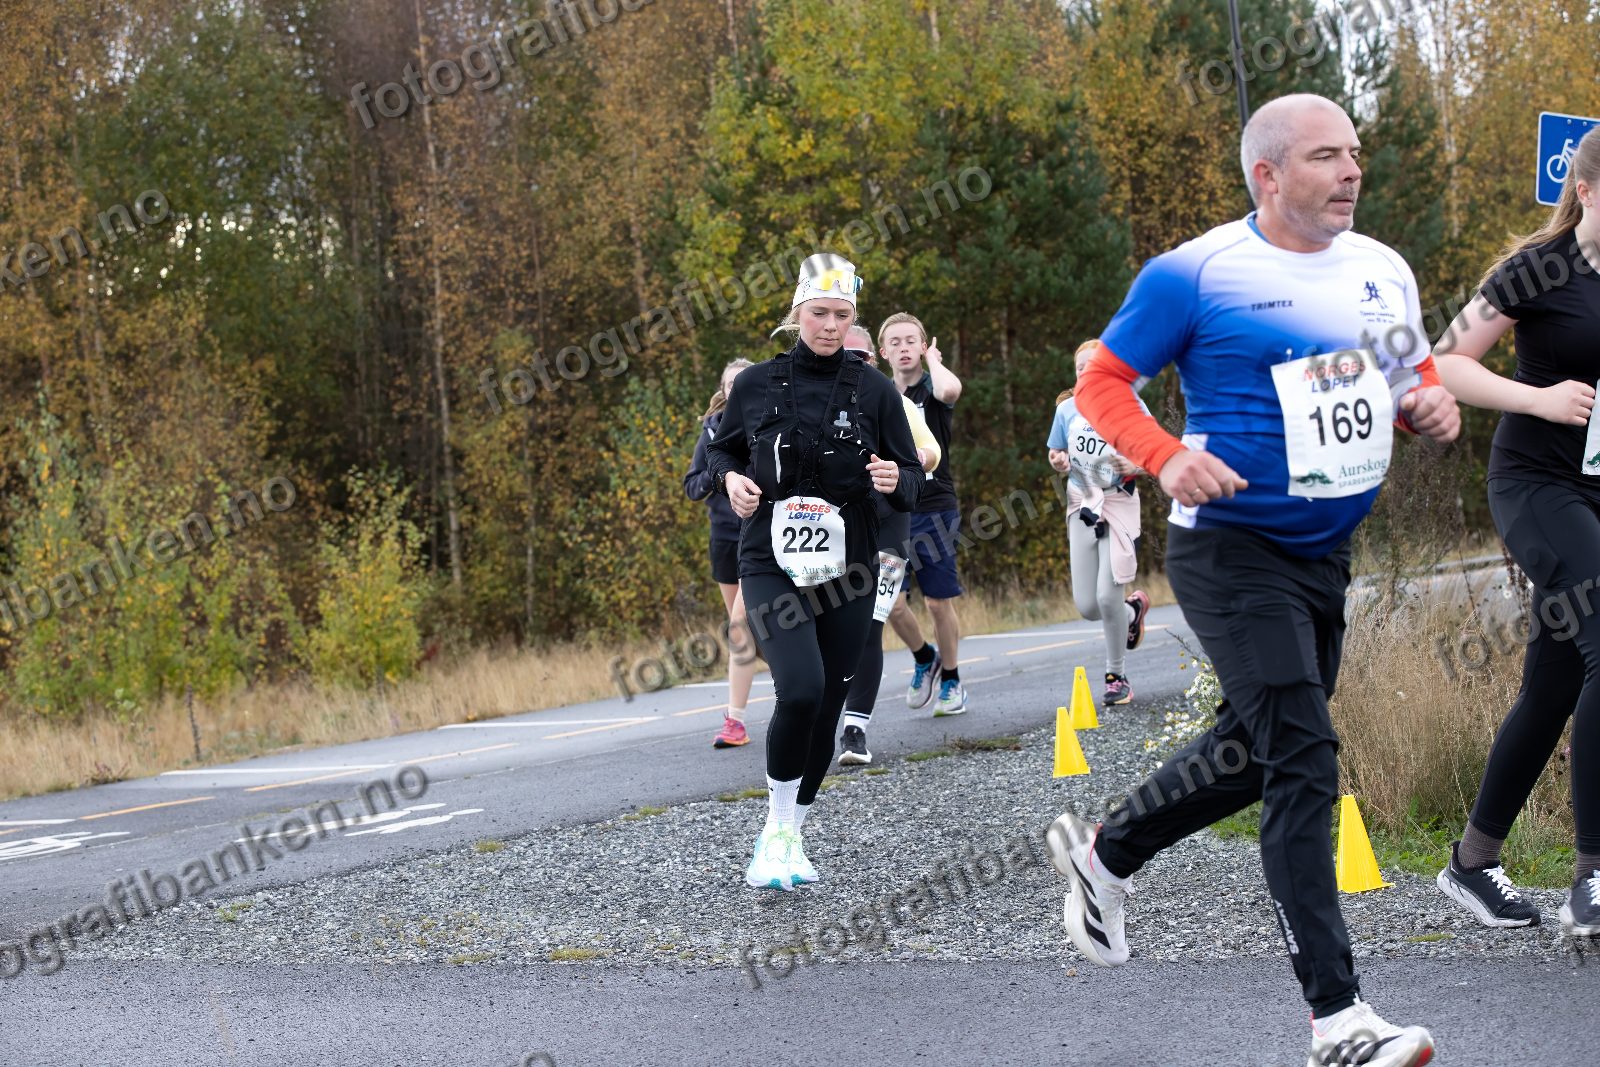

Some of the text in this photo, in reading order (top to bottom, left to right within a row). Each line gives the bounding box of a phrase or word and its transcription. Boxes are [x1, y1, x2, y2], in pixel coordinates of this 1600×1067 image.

[1251, 300, 1293, 311] TRIMTEX
[1303, 360, 1366, 381] NORGES
[1309, 398, 1373, 446] 169
[1076, 436, 1107, 456] 307
[1339, 458, 1388, 478] Aurskog
[784, 502, 831, 513] NORGES
[782, 526, 830, 553] 222
[801, 564, 843, 576] Aurskog
